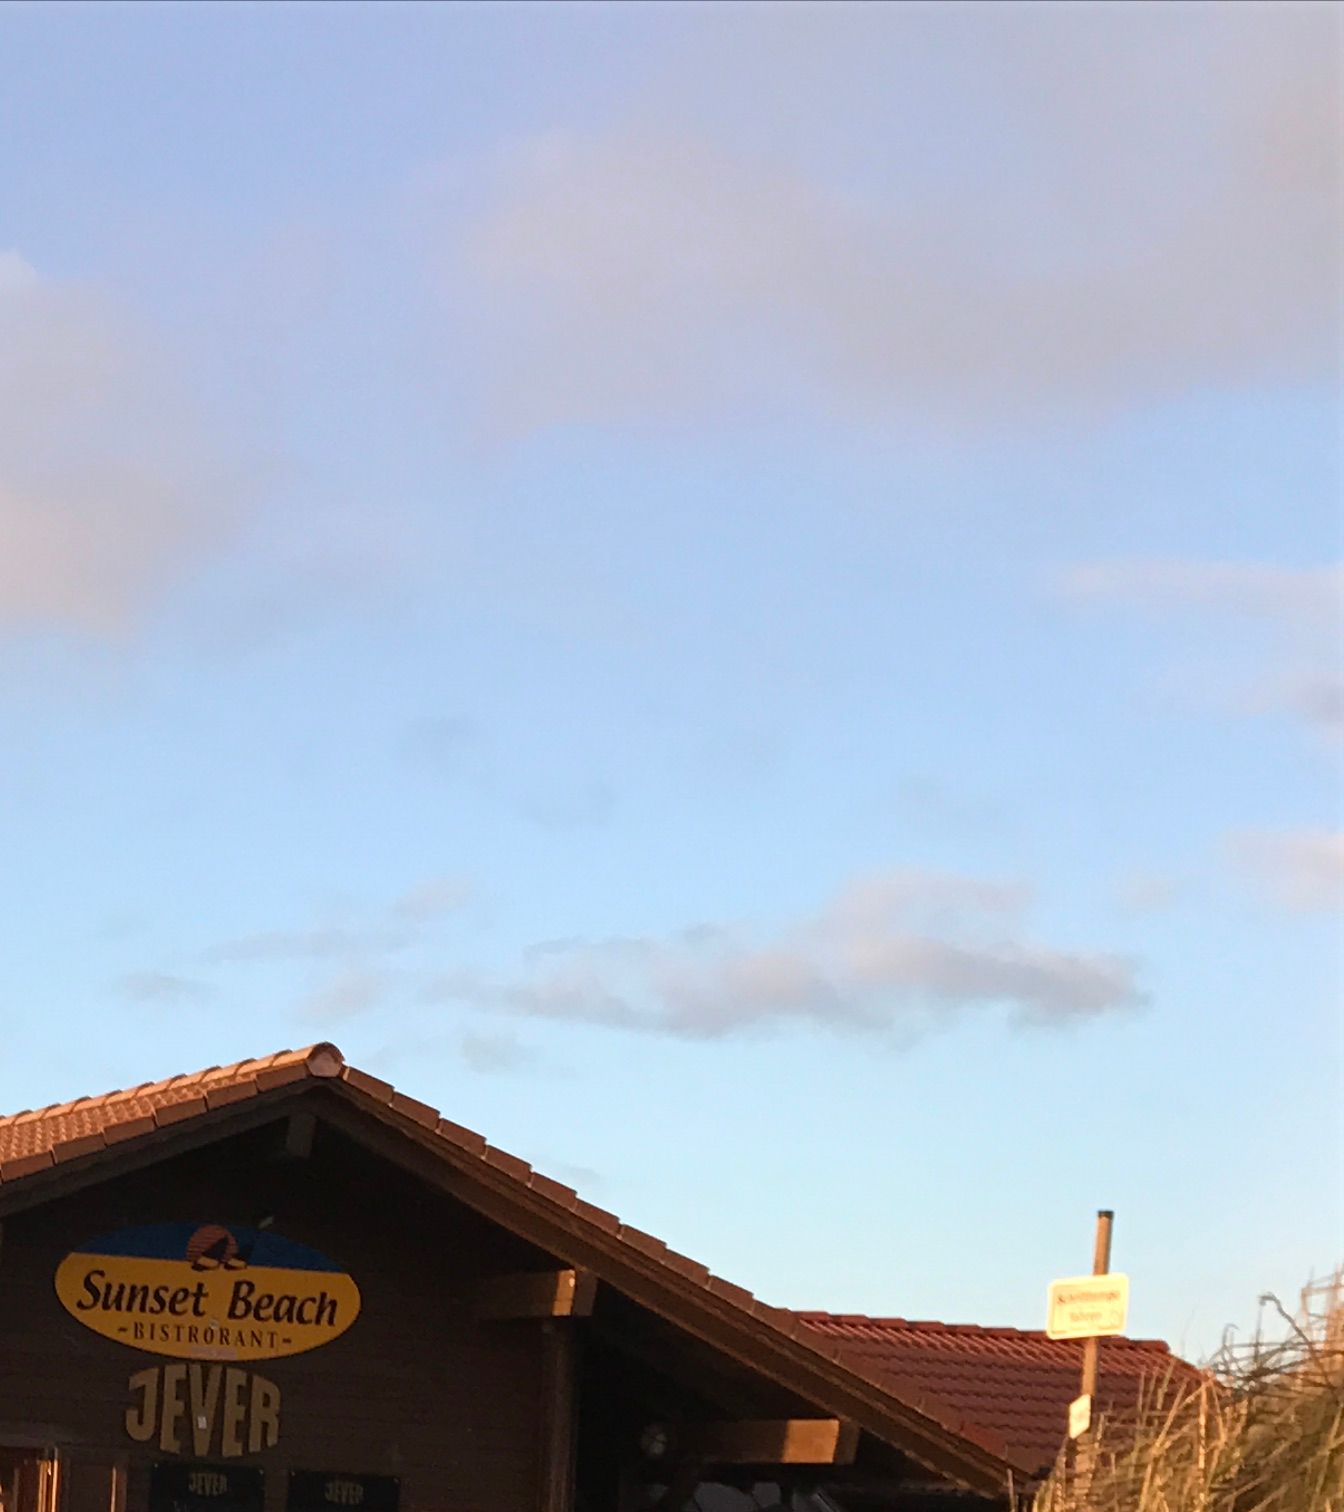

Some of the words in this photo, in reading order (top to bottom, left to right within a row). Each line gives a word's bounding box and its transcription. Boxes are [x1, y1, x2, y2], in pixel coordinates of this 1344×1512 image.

[76, 1270, 210, 1318] Sunset
[227, 1280, 339, 1328] Beach
[125, 1363, 282, 1458] JEVER
[189, 1472, 228, 1497] JEVER
[324, 1480, 365, 1505] JEVER
